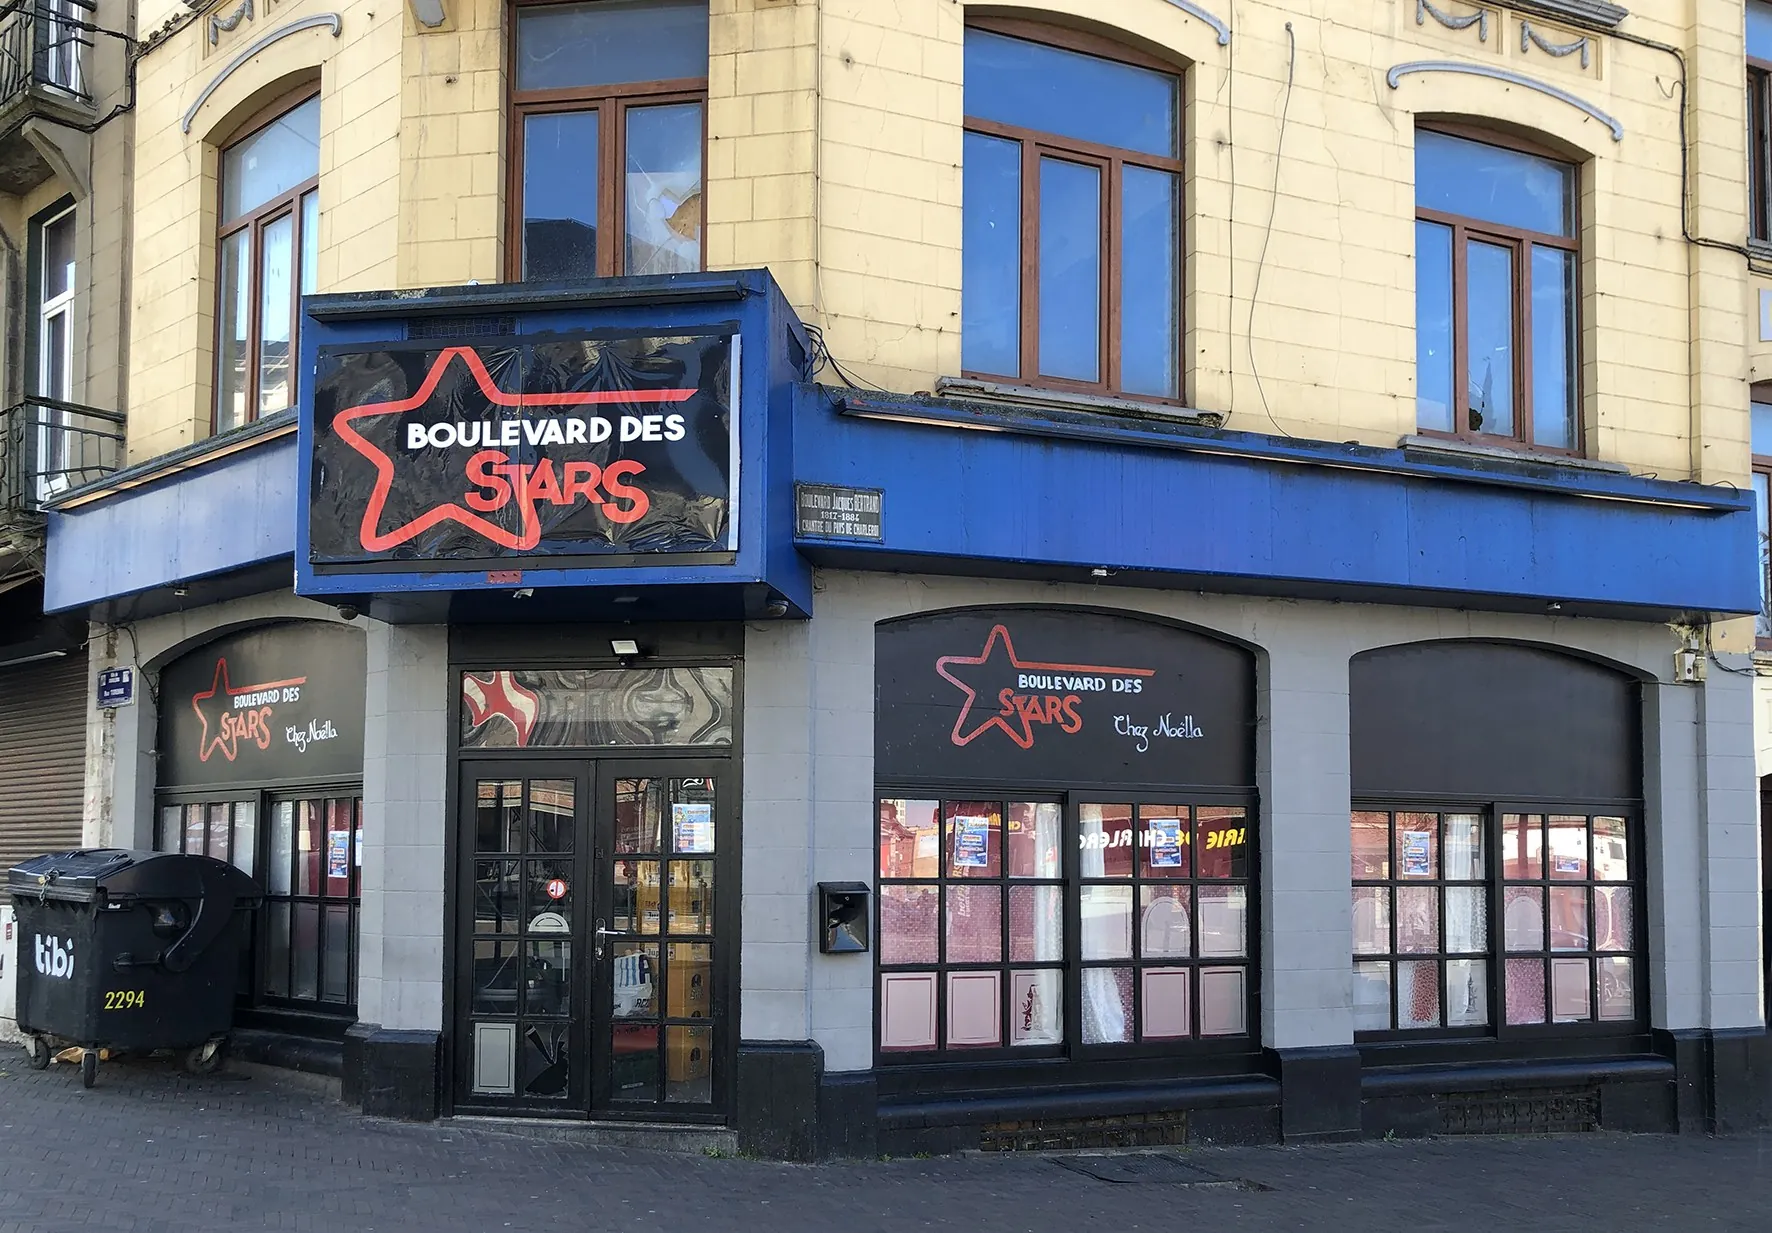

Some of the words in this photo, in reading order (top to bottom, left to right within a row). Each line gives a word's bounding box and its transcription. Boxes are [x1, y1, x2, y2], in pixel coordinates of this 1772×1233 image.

[407, 415, 613, 449] BOULEVARD
[620, 414, 686, 442] DES
[465, 449, 650, 524] STARS
[801, 492, 831, 508] BOULEVARD
[233, 688, 280, 709] BOULEVARD
[282, 686, 300, 703] DES
[1018, 674, 1106, 692] BOULEVARD
[1112, 678, 1143, 694] DES
[220, 706, 273, 750] STARS
[999, 688, 1083, 734] STARS
[285, 723, 306, 753] Chez
[307, 718, 338, 744] Noëlla
[1113, 714, 1149, 752] Chez
[1154, 713, 1204, 738] Noëlla
[34, 933, 76, 980] tibi
[104, 990, 145, 1010] 2294
